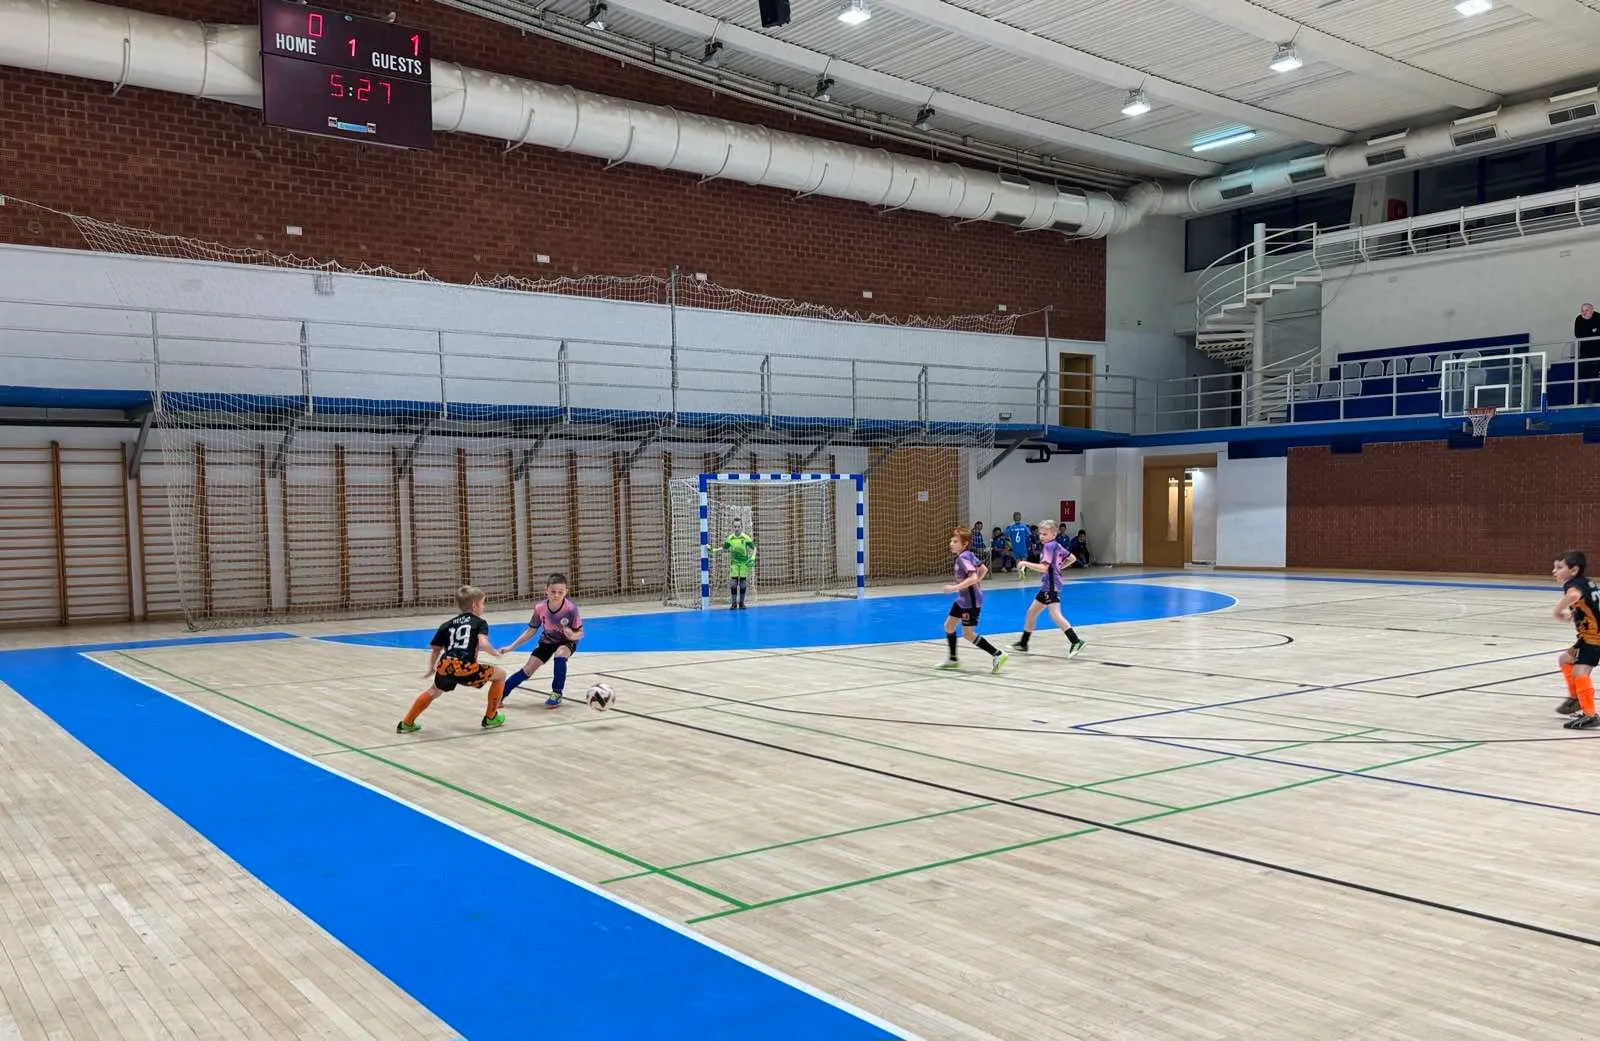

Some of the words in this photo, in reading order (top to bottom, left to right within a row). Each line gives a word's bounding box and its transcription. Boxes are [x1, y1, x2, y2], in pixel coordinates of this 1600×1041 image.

[308, 12, 323, 38] 0
[275, 33, 317, 56] HOME
[348, 38, 356, 57] 1
[410, 34, 421, 57] 1
[371, 51, 423, 76] GUESTS
[330, 73, 391, 104] 5:27
[1015, 531, 1021, 543] 6
[447, 624, 472, 651] 19
